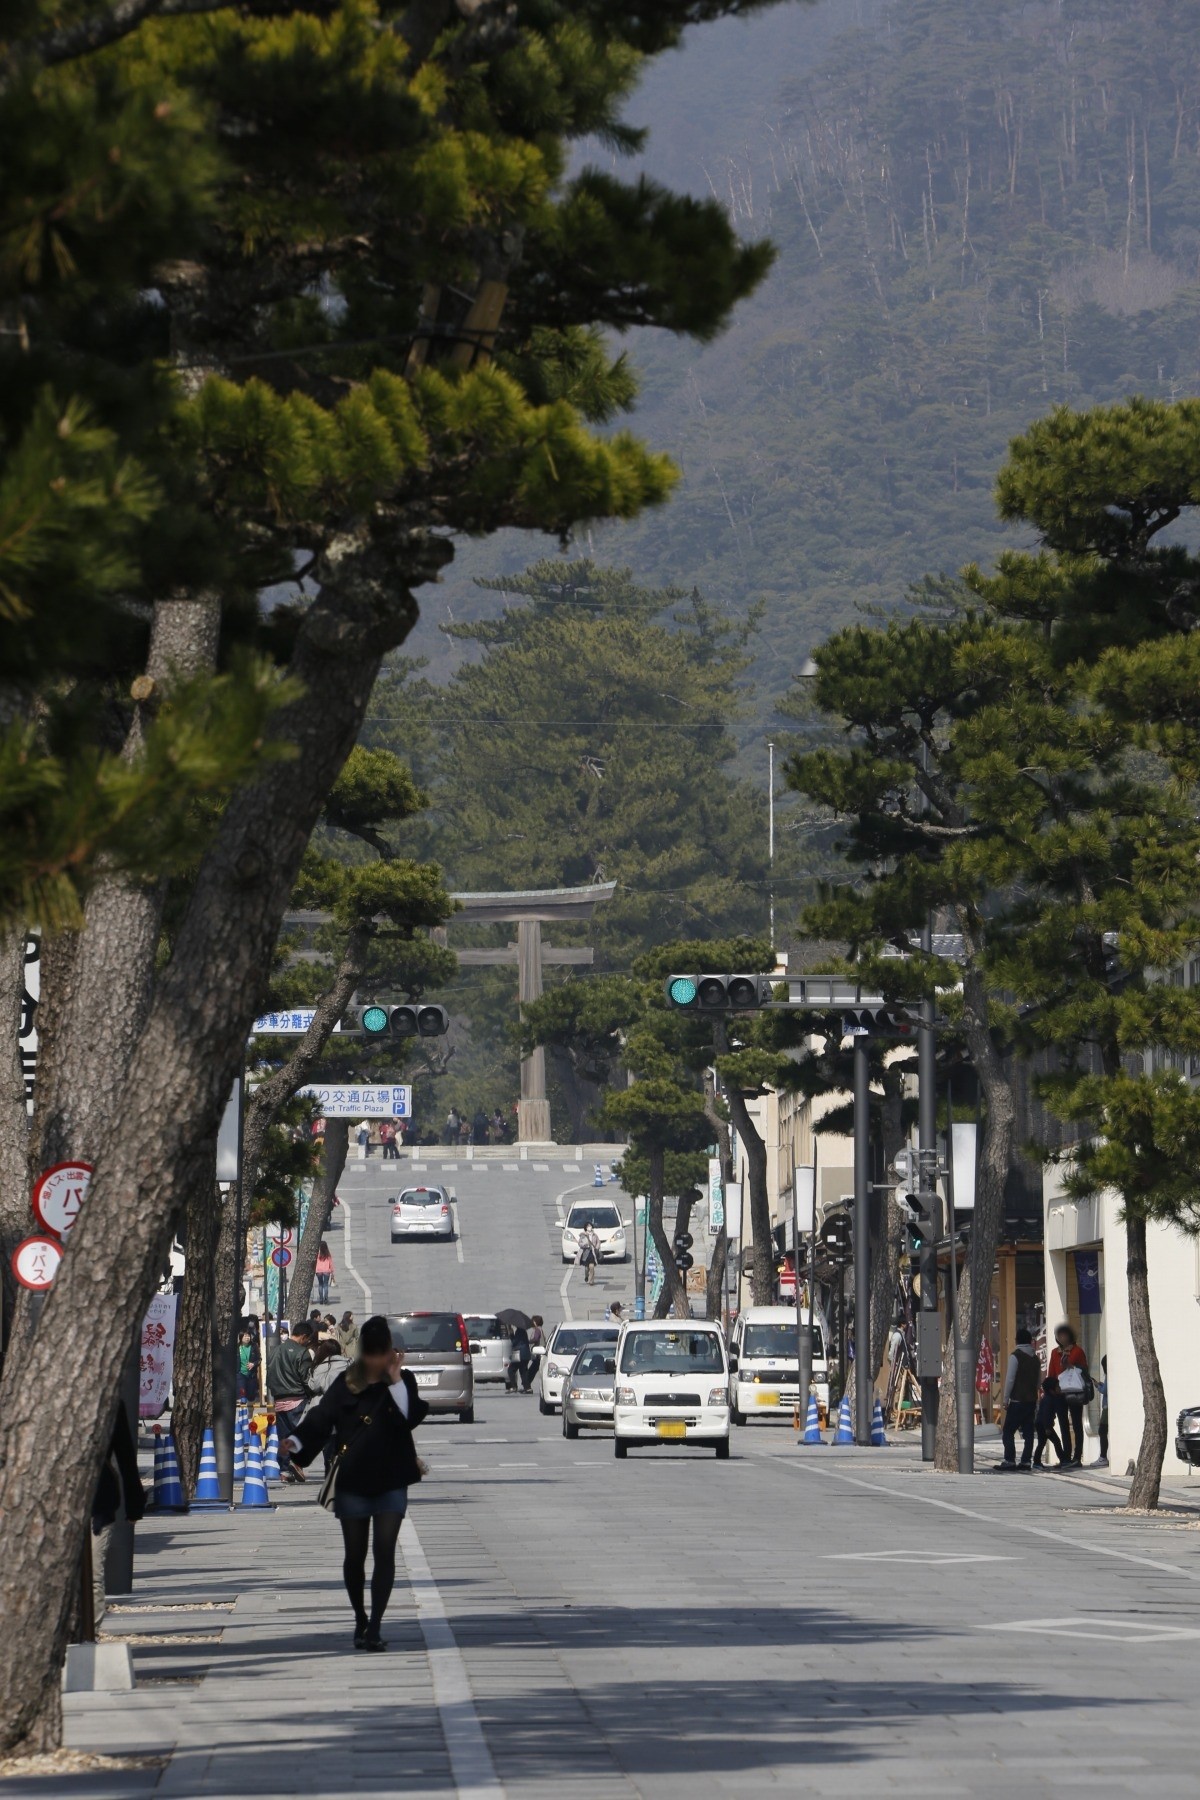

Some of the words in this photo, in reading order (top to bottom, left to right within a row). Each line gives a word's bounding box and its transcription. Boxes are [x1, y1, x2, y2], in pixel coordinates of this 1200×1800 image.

[257, 1013, 314, 1029] 歩車分離式
[338, 1104, 361, 1112] Traffic
[364, 1105, 384, 1113] Plaza
[32, 1255, 46, 1281] バス
